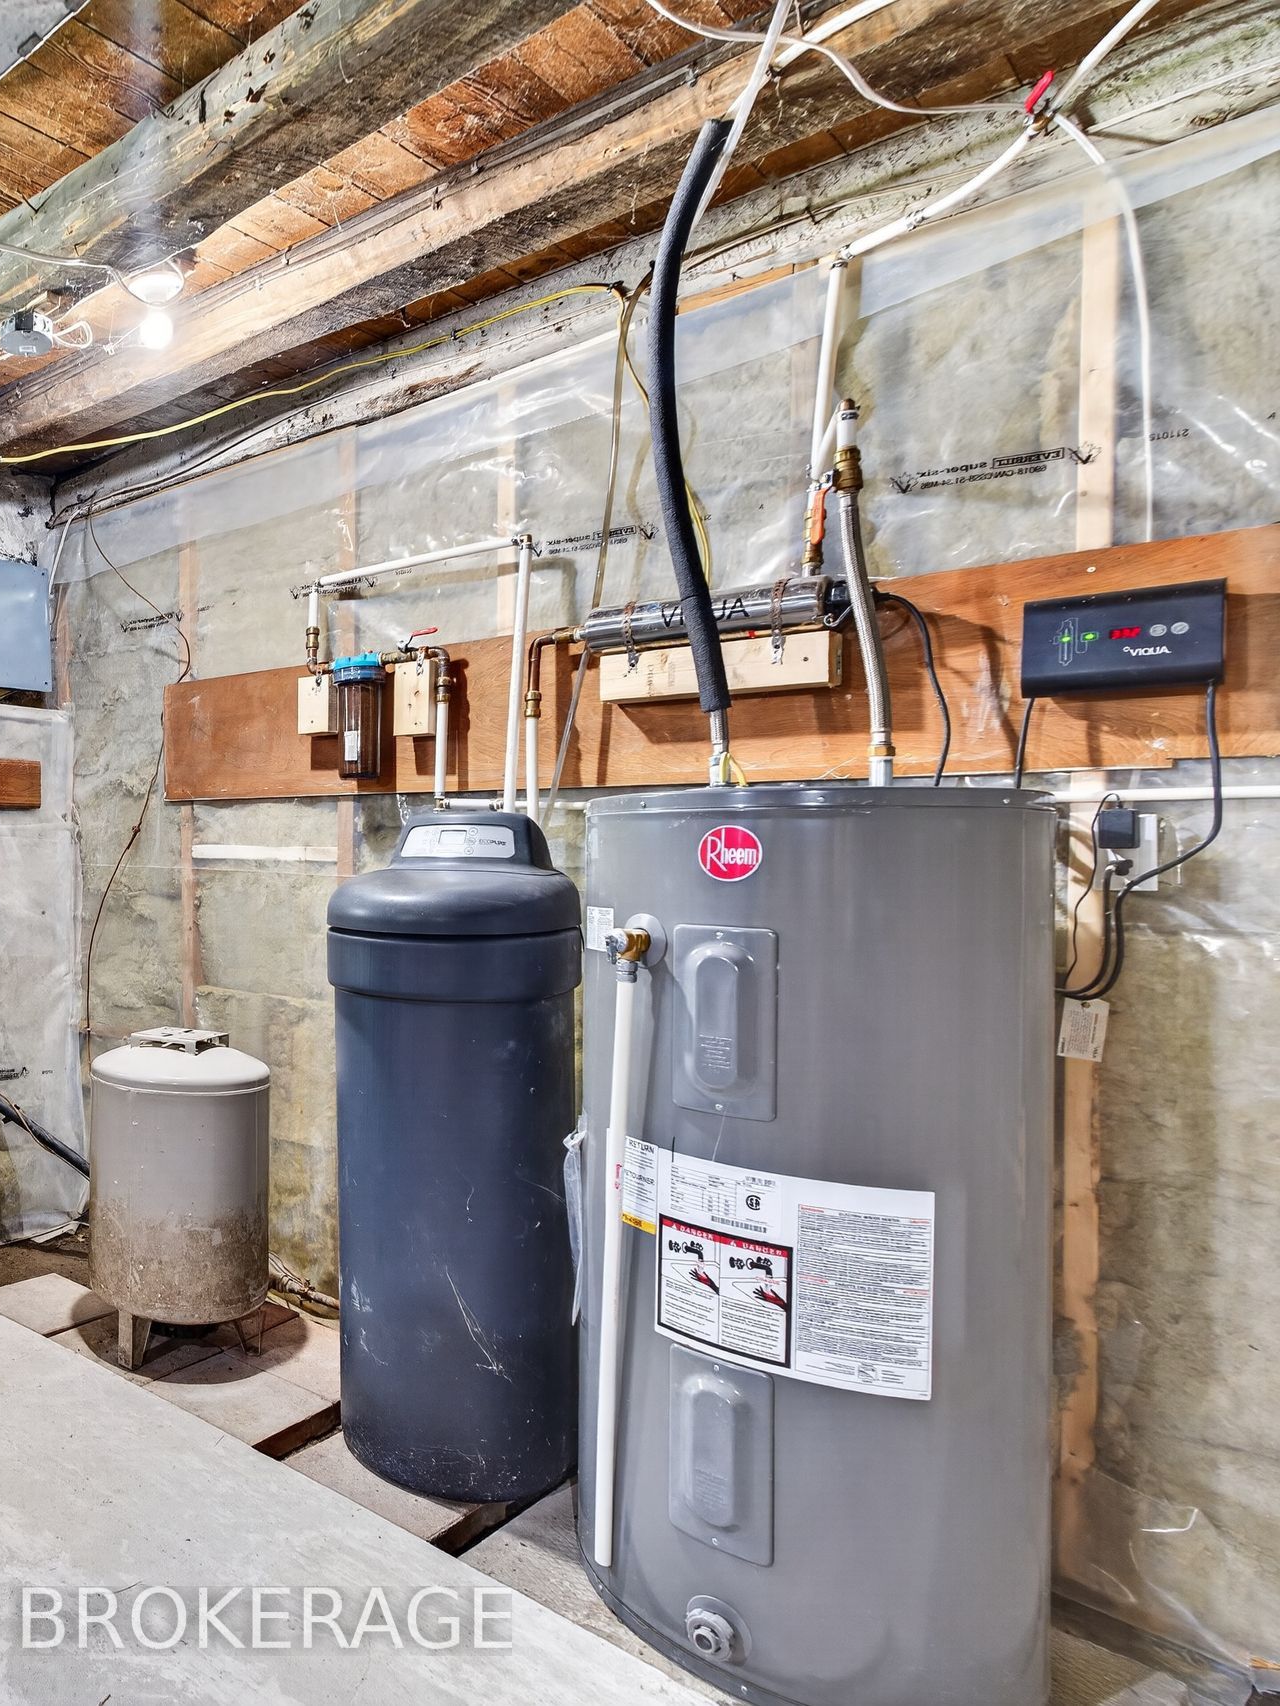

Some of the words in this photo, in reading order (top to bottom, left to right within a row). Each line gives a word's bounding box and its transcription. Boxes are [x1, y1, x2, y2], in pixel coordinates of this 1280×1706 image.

[661, 597, 751, 628] VIUA
[1129, 646, 1171, 657] VIQUA
[706, 828, 757, 872] Rheem
[628, 1138, 655, 1155] RETURN
[679, 1226, 714, 1241] DANGER
[742, 1242, 783, 1257] DANGER
